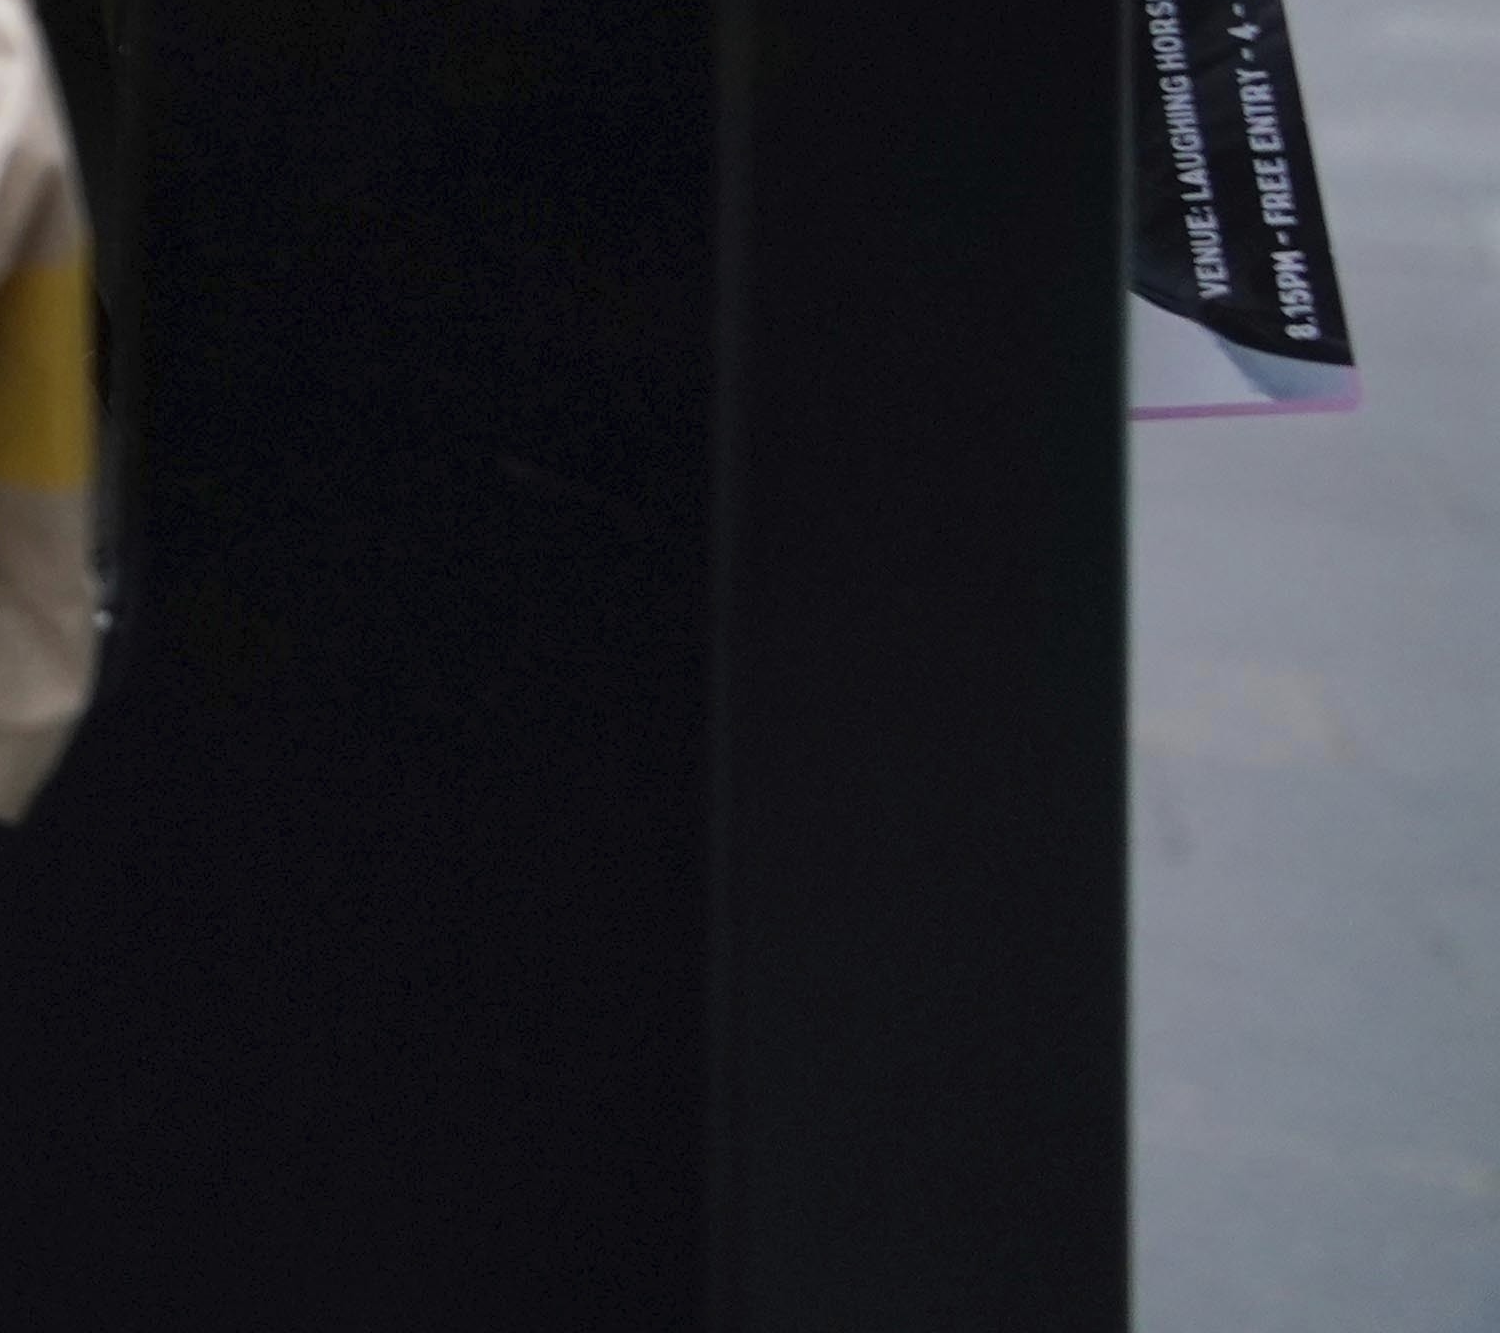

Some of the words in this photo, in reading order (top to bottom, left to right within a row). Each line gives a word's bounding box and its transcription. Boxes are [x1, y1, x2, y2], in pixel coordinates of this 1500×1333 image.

[1158, 73, 1214, 201] LAUGHING
[1236, 69, 1284, 153] ENTRY
[1252, 157, 1298, 227] FREE
[1184, 205, 1232, 300] VENUE:
